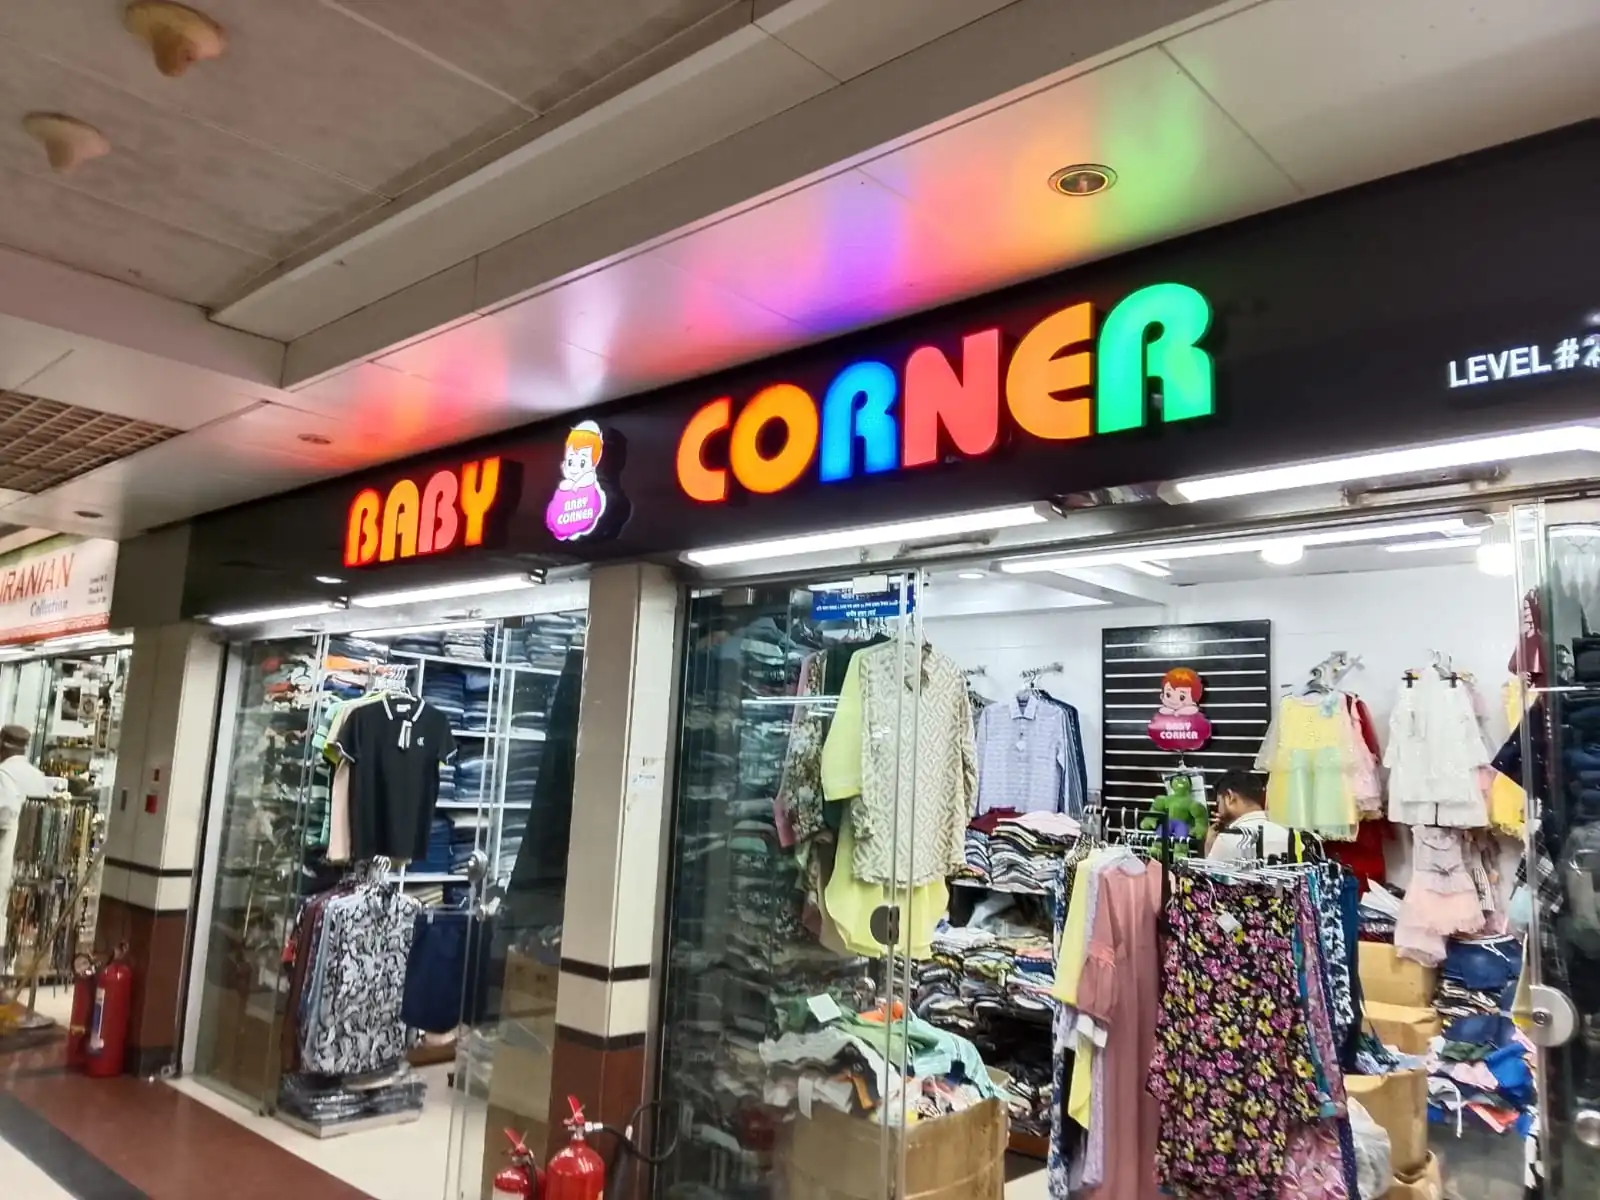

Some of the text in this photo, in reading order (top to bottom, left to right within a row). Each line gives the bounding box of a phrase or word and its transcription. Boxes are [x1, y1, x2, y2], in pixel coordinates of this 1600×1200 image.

[1449, 345, 1552, 388] LEVEL
[342, 282, 1216, 567] BABY CORNER
[564, 496, 588, 512] BABY
[557, 508, 593, 525] CORNER
[1159, 730, 1199, 740] CORNER
